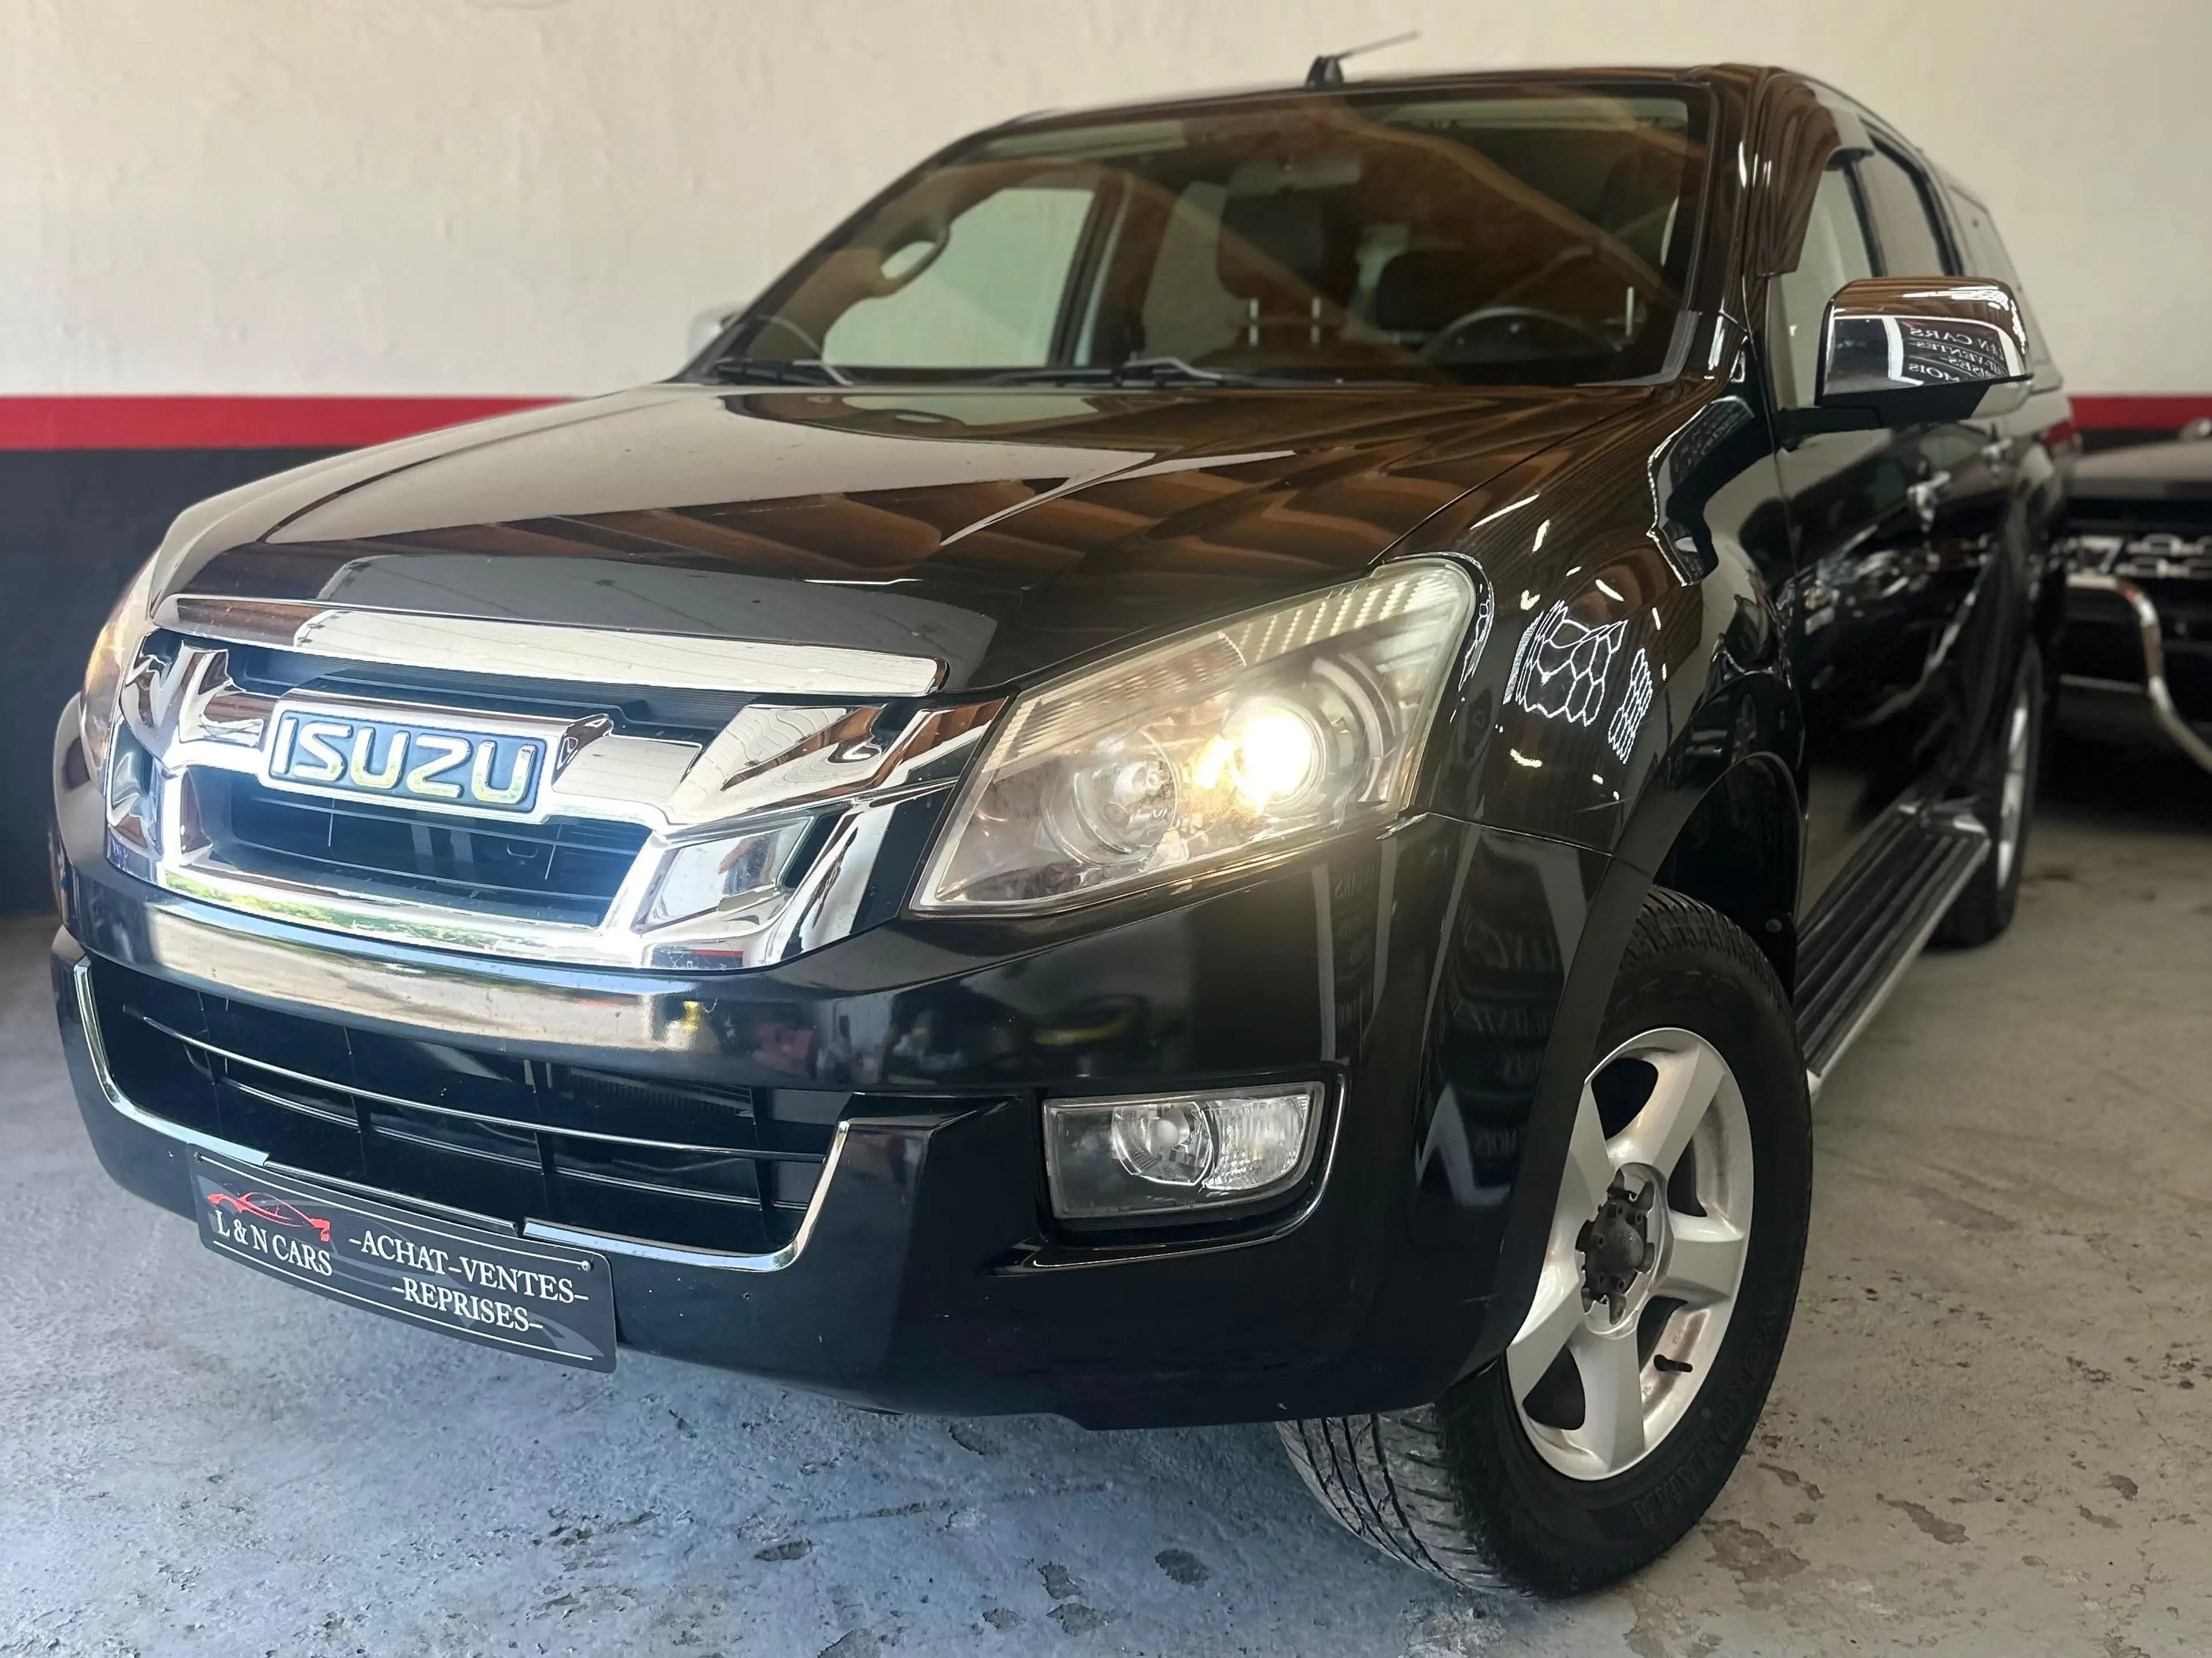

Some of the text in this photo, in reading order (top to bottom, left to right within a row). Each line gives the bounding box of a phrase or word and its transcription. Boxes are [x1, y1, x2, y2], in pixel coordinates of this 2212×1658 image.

[271, 717, 536, 805] ISUZU
[215, 1209, 333, 1276] L & N CARS
